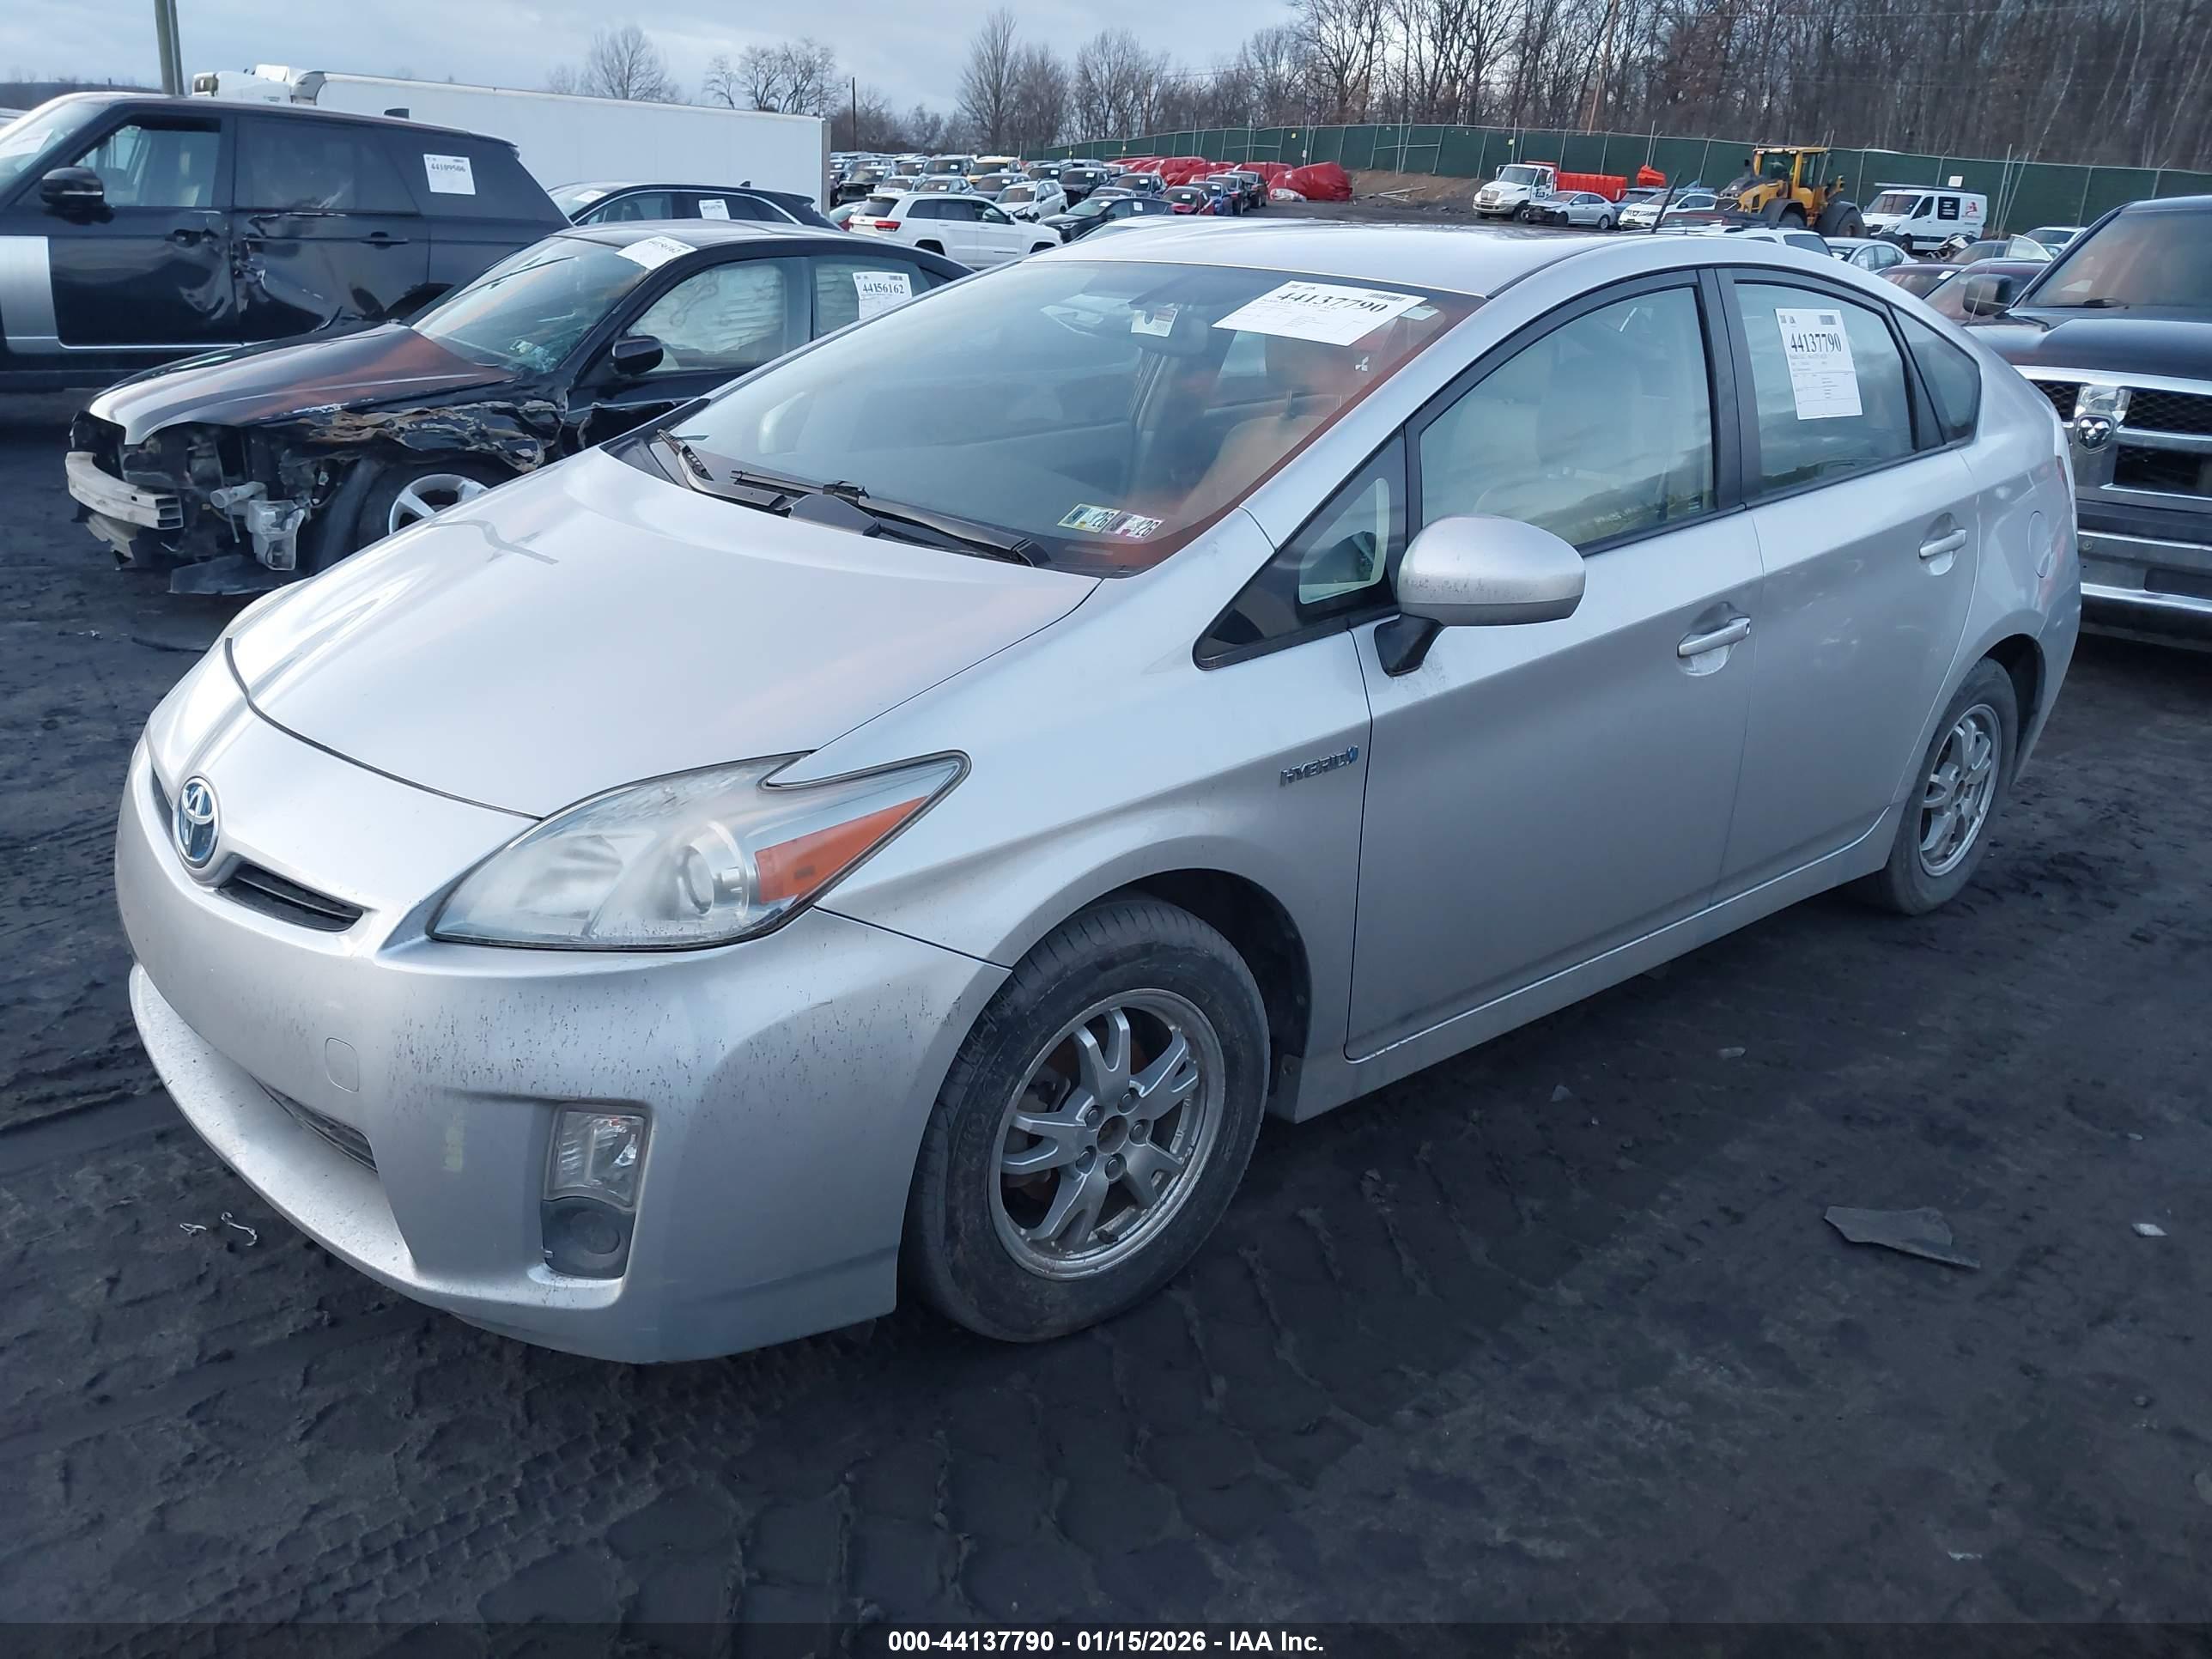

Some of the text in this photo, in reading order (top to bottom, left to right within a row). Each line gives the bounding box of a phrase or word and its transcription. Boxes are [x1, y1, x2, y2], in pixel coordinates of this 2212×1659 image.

[862, 283, 905, 295] 44156162
[1276, 291, 1389, 313] 44137790
[1790, 332, 1842, 353] 44137790
[1279, 745, 1358, 787] HYBRID
